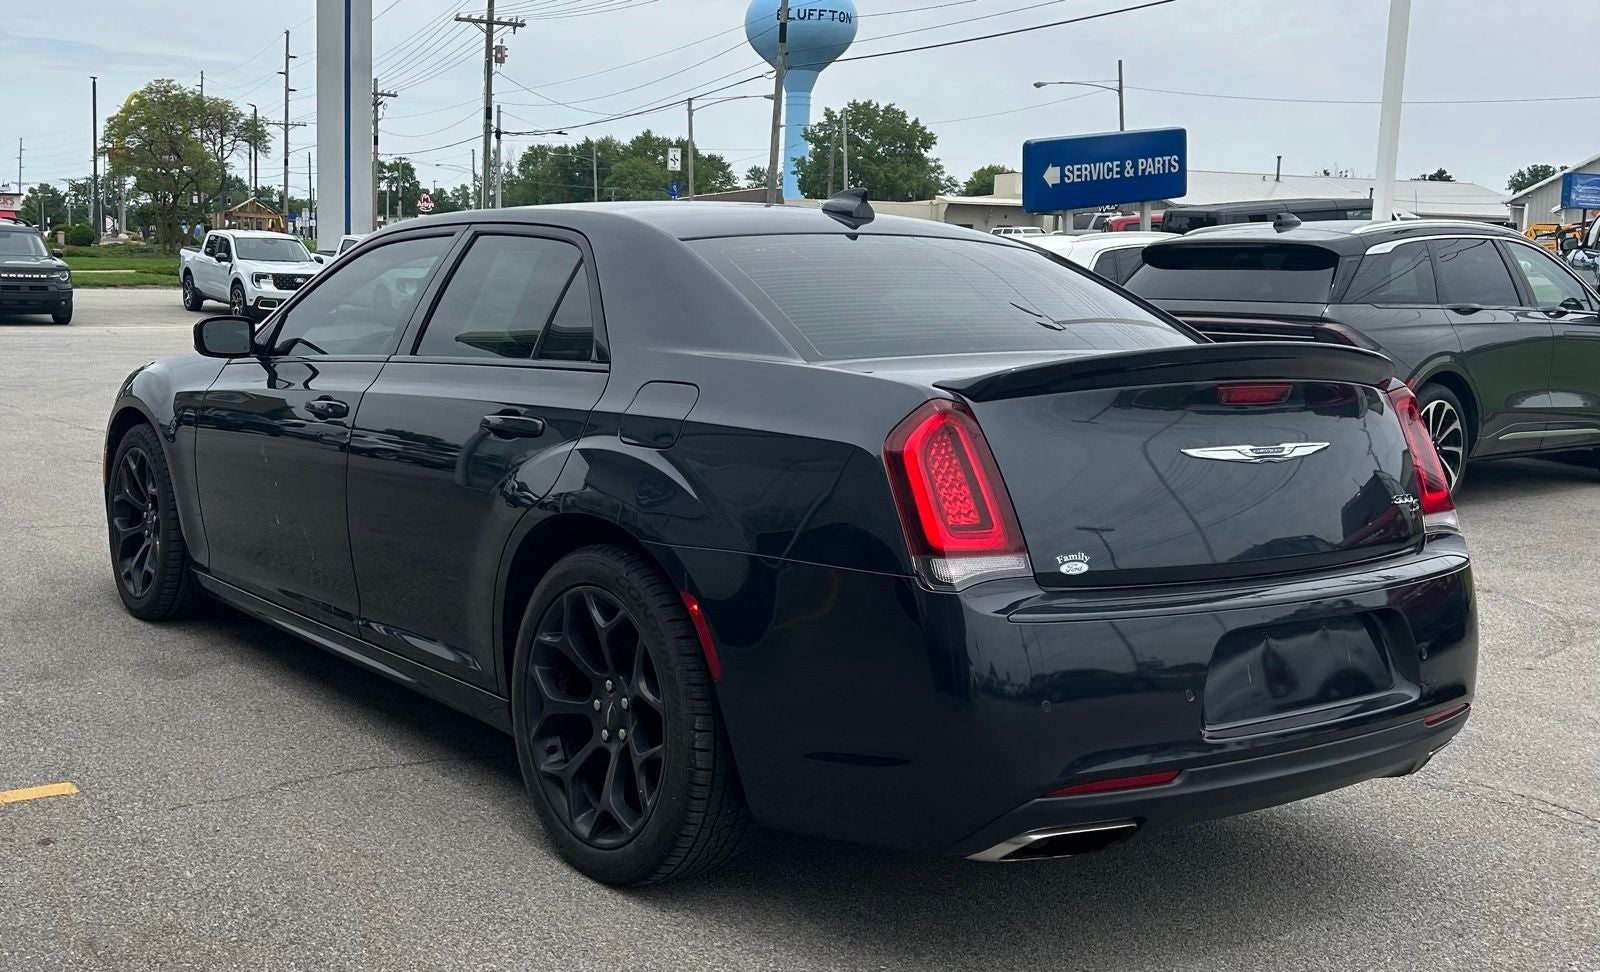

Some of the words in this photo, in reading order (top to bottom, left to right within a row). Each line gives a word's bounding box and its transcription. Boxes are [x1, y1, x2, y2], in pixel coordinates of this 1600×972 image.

[1064, 160, 1121, 184] SERVICE
[1124, 159, 1135, 178] &
[1138, 154, 1180, 176] PARTS
[1056, 552, 1091, 564] Family
